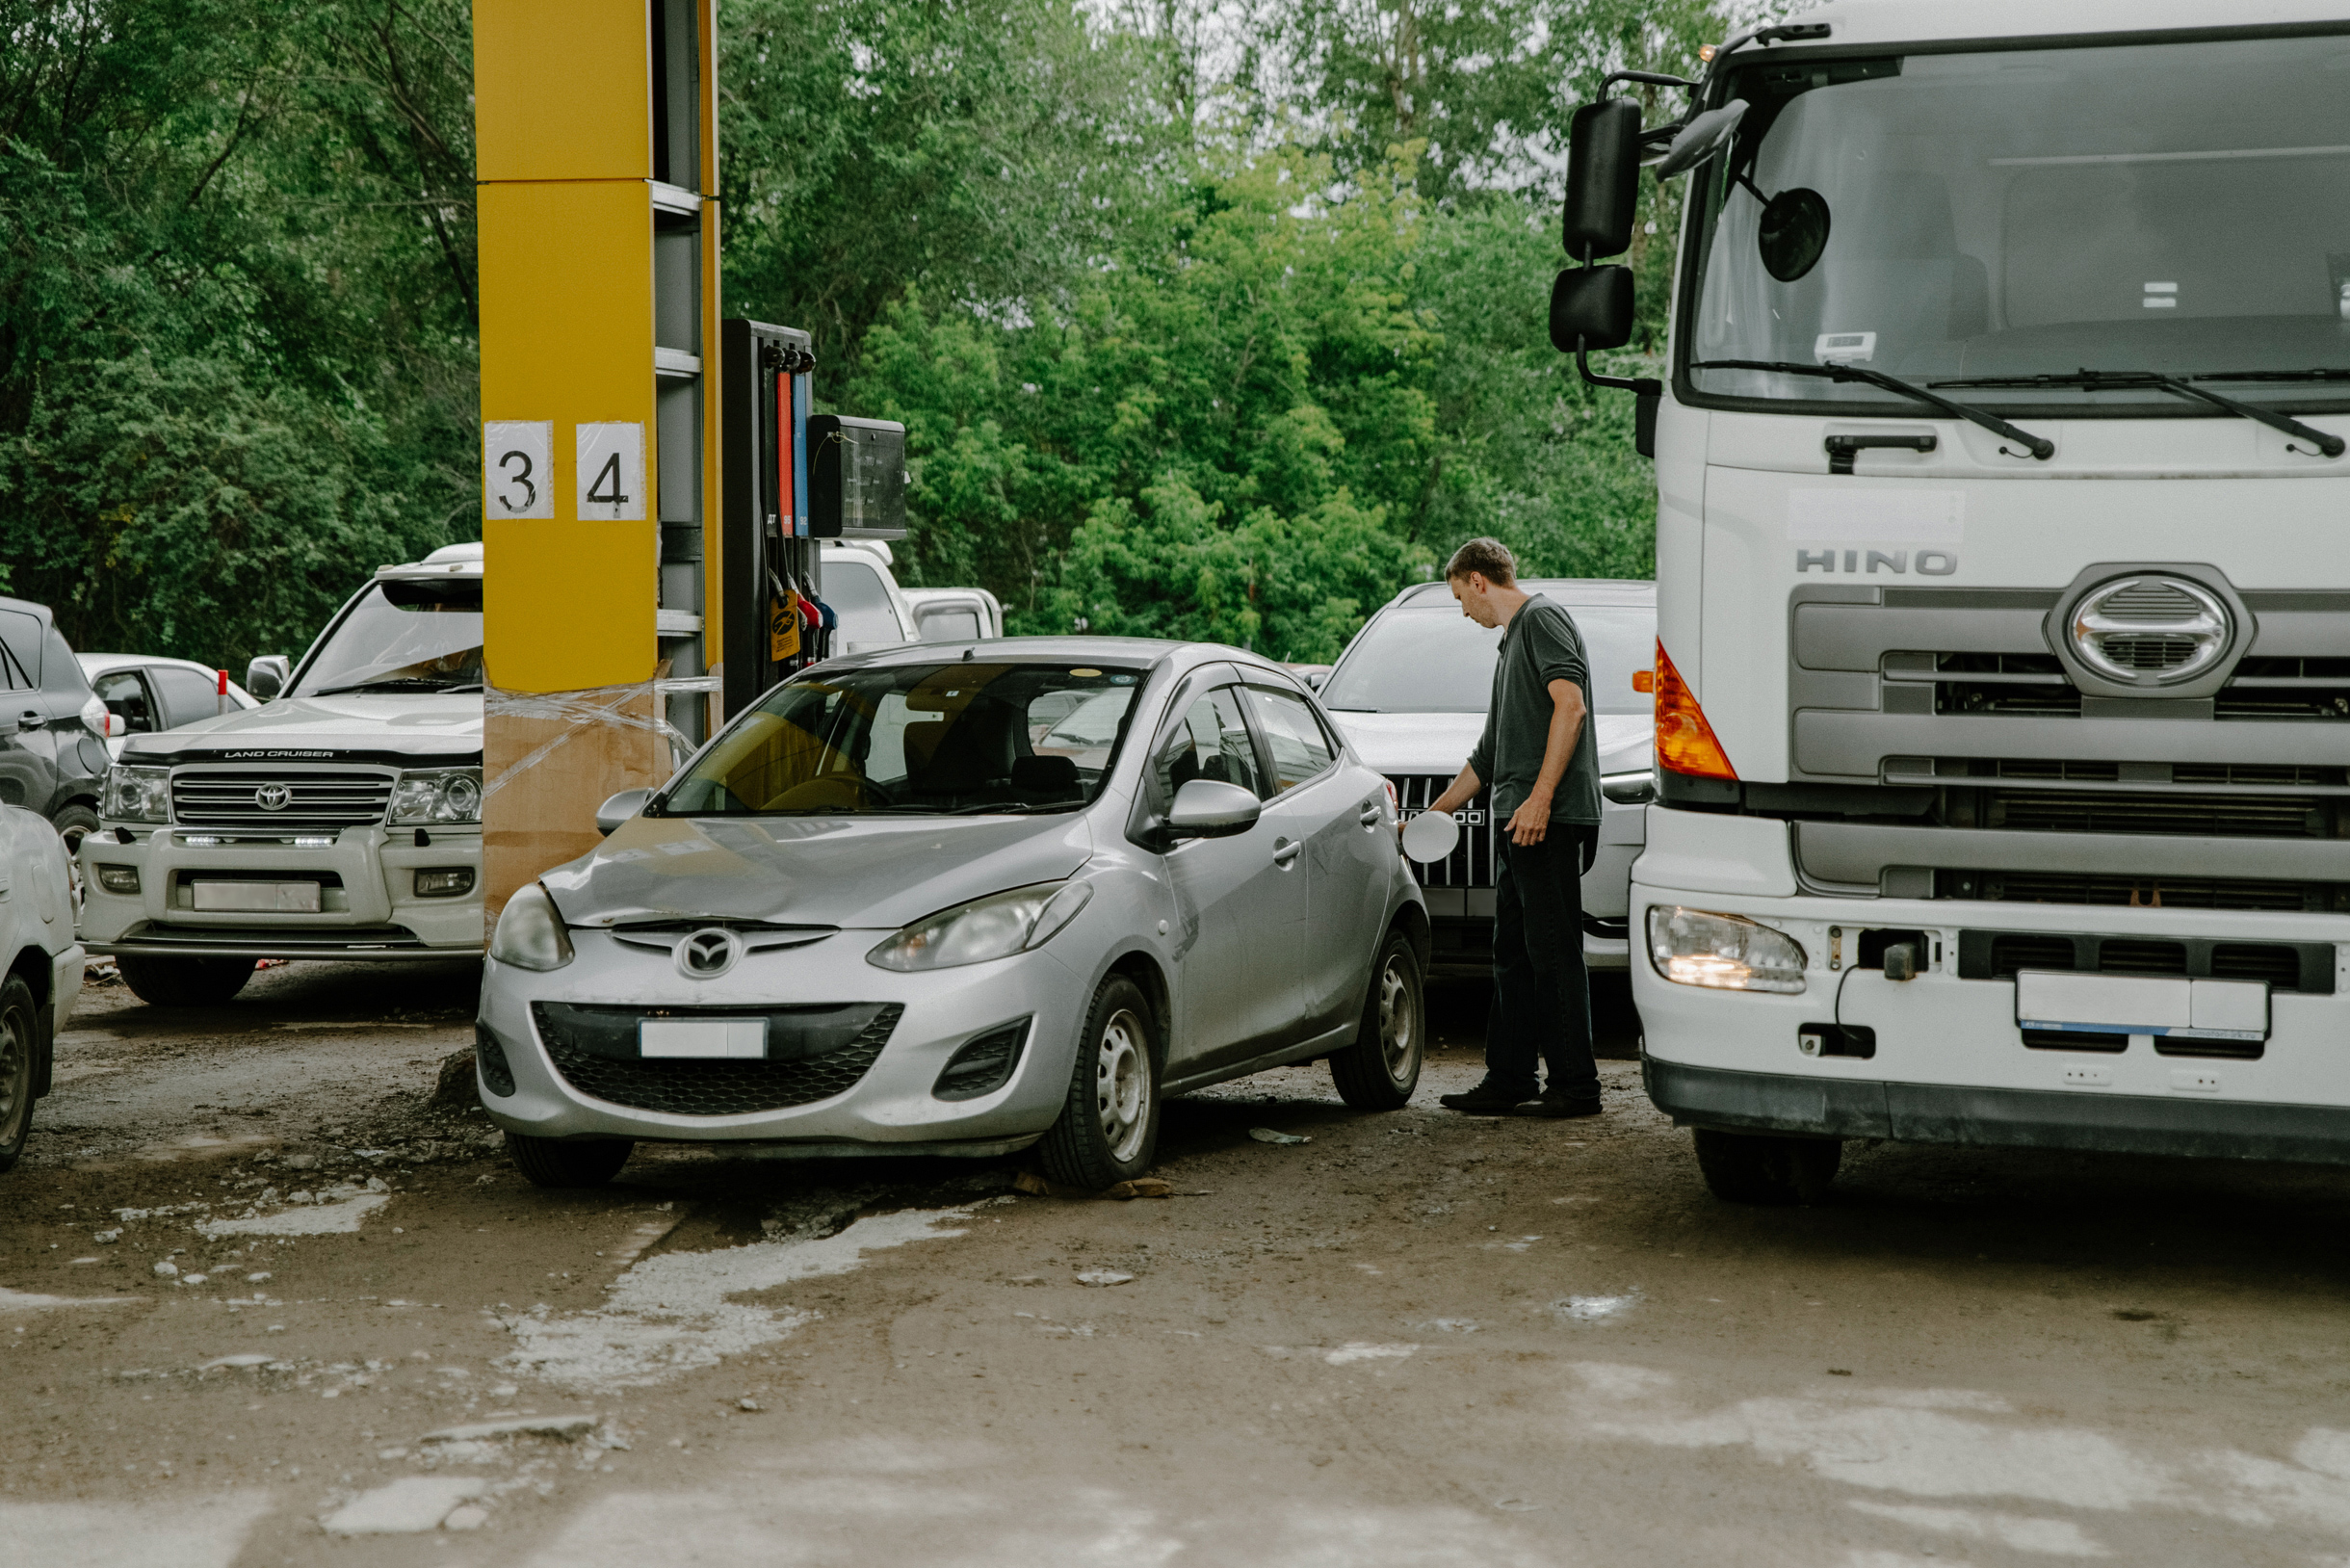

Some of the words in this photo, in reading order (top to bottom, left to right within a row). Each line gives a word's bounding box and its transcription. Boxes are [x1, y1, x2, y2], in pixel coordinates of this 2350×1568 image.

[498, 450, 536, 513] 3
[587, 453, 629, 519] 4
[768, 514, 776, 525] ДТ
[783, 515, 792, 525] 95
[799, 516, 807, 526] 92
[1796, 549, 1958, 576] HINO
